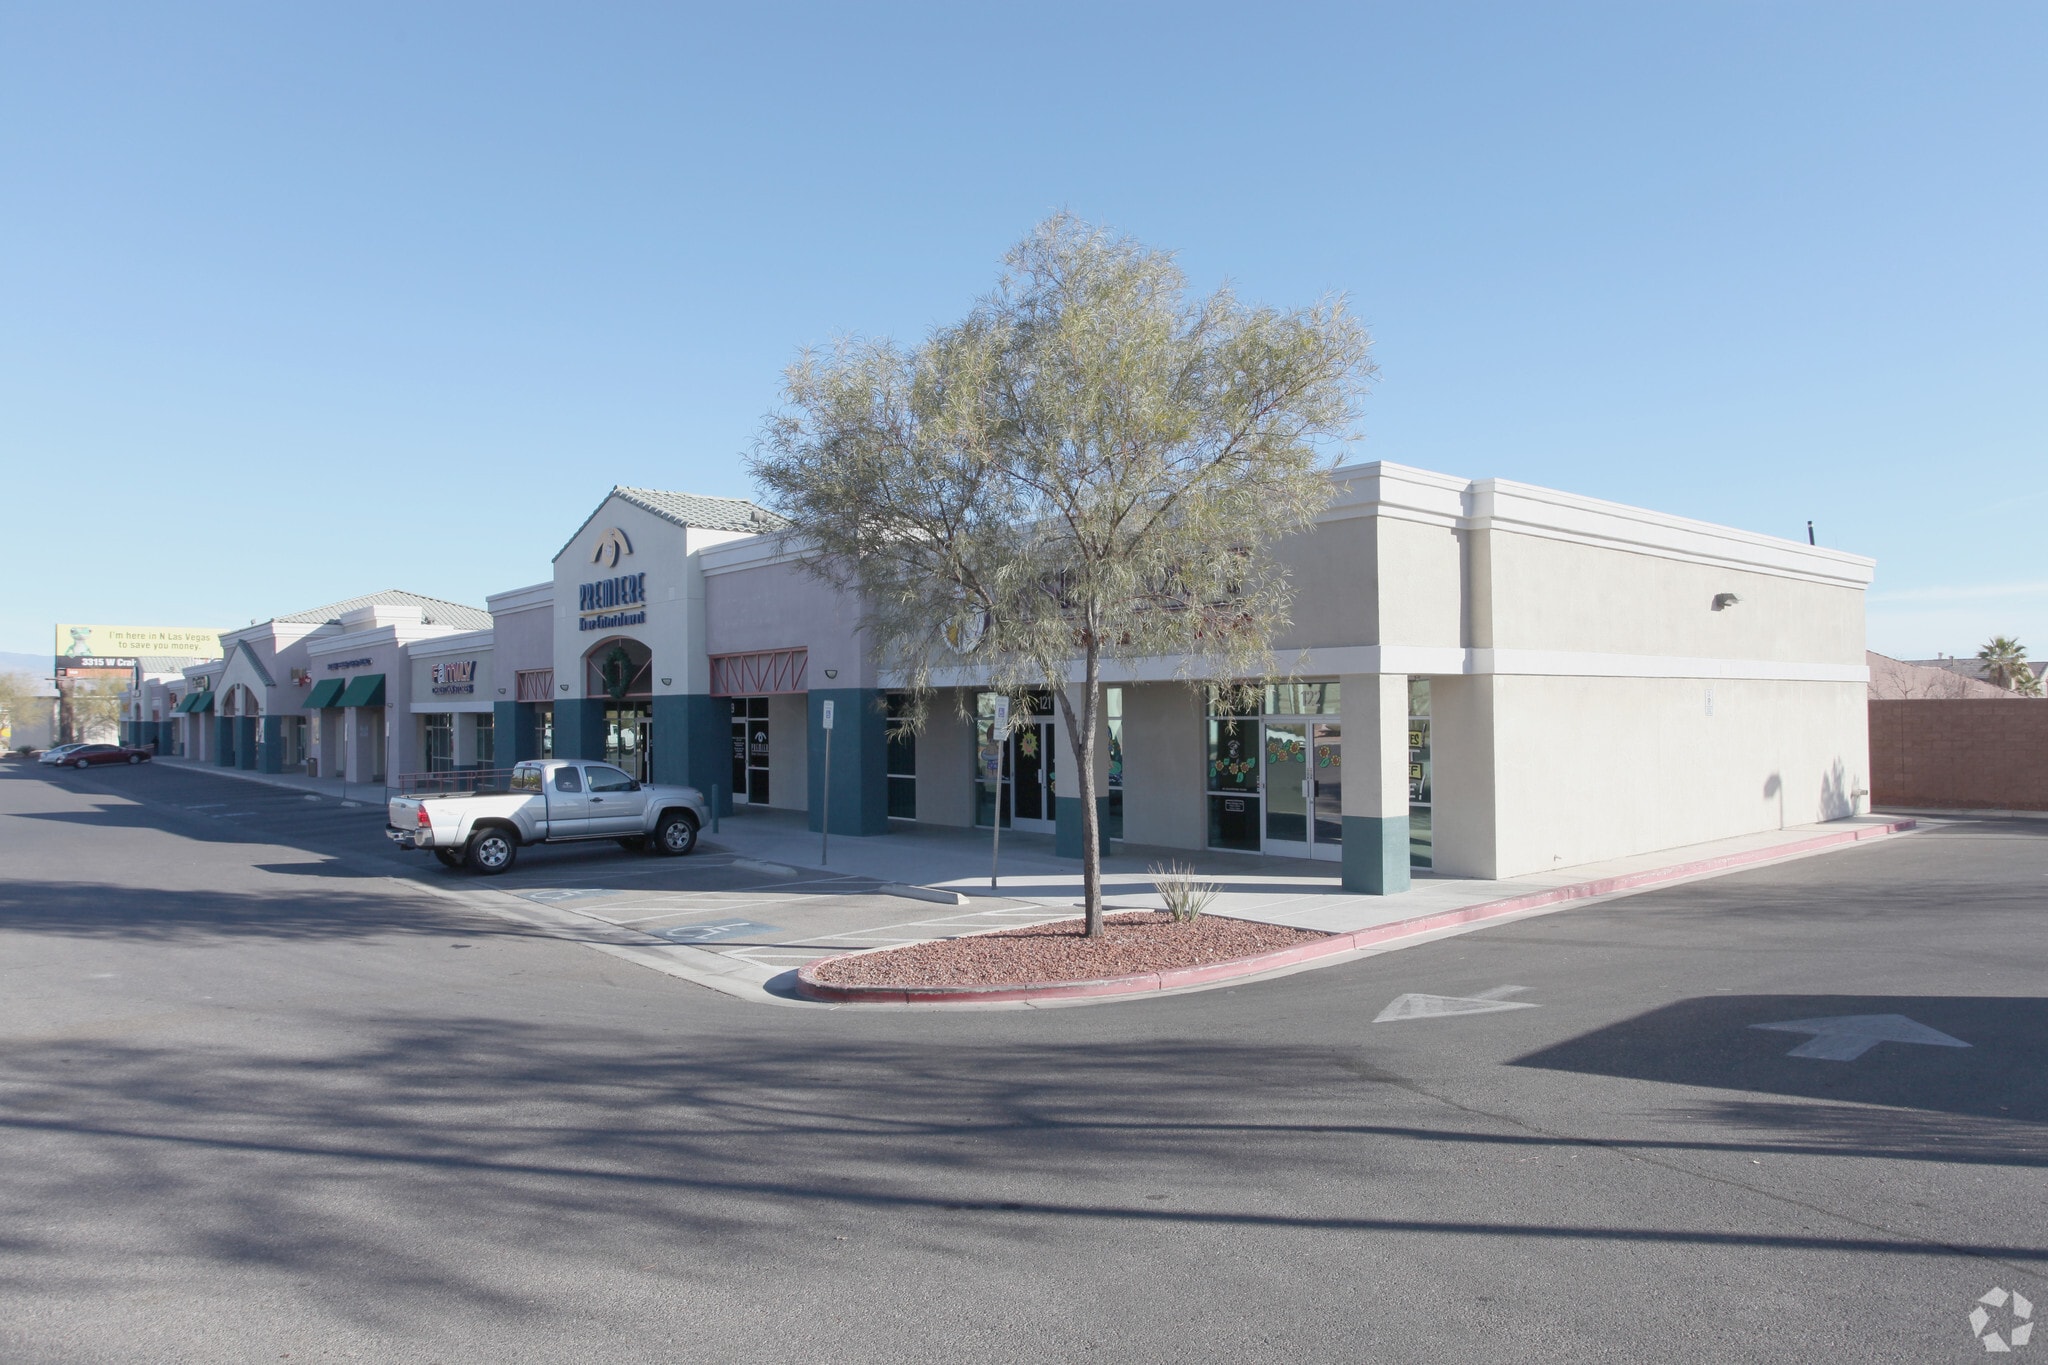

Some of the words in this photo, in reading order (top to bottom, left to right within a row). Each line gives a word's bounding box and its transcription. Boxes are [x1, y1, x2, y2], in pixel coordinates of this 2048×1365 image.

[579, 572, 646, 611] PREMIERE
[109, 631, 124, 640] I'm
[126, 632, 146, 640] here
[148, 632, 157, 640] in
[159, 632, 165, 641] N
[168, 632, 183, 641] Las
[185, 633, 211, 643] Vegas
[118, 641, 128, 649] to
[153, 642, 169, 651] you
[171, 643, 201, 652] money.
[81, 657, 105, 666] 3315
[105, 658, 116, 667] W
[117, 658, 136, 667] Crai
[1039, 695, 1051, 710] 121
[1301, 690, 1321, 707] 122
